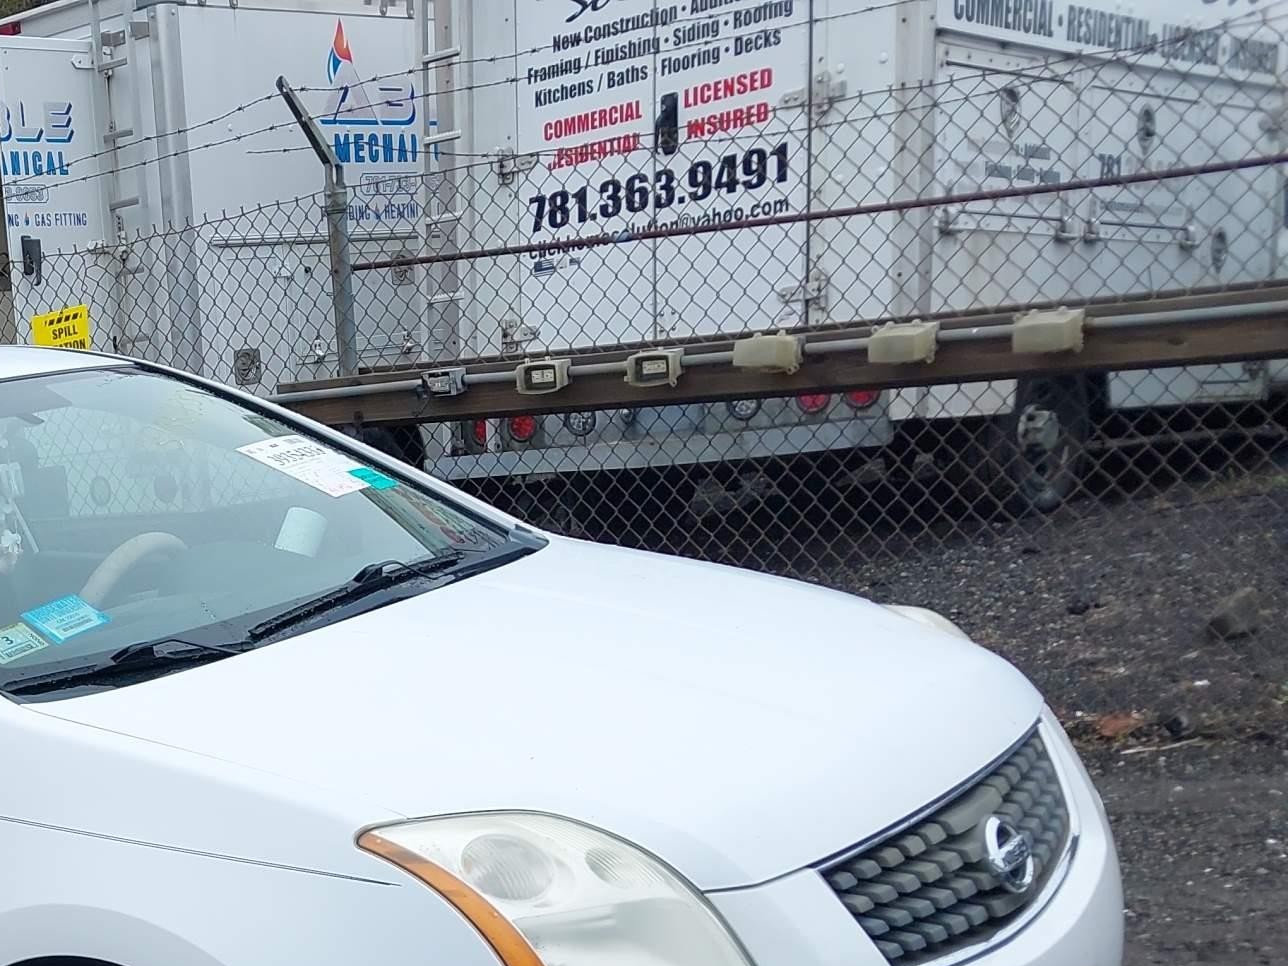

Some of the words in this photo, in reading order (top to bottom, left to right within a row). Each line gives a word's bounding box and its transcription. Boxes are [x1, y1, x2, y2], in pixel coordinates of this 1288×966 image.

[527, 56, 582, 85] Framing
[594, 36, 661, 67] Finishing
[673, 19, 720, 47] Siding
[733, 0, 794, 30] Roofing
[552, 31, 582, 54] New
[584, 5, 678, 45] Construction
[534, 79, 594, 108] Kitchens
[607, 64, 649, 89] Baths
[660, 45, 721, 77] Flooring
[734, 29, 782, 56] Decks
[683, 67, 774, 109] LICENSED
[543, 100, 643, 142] COMMERCIAL
[687, 101, 770, 140] INSURED
[528, 142, 789, 234] 781.363.9491
[34, 212, 53, 227] GAS
[54, 212, 88, 227] FITTING
[51, 324, 79, 341] SPILL
